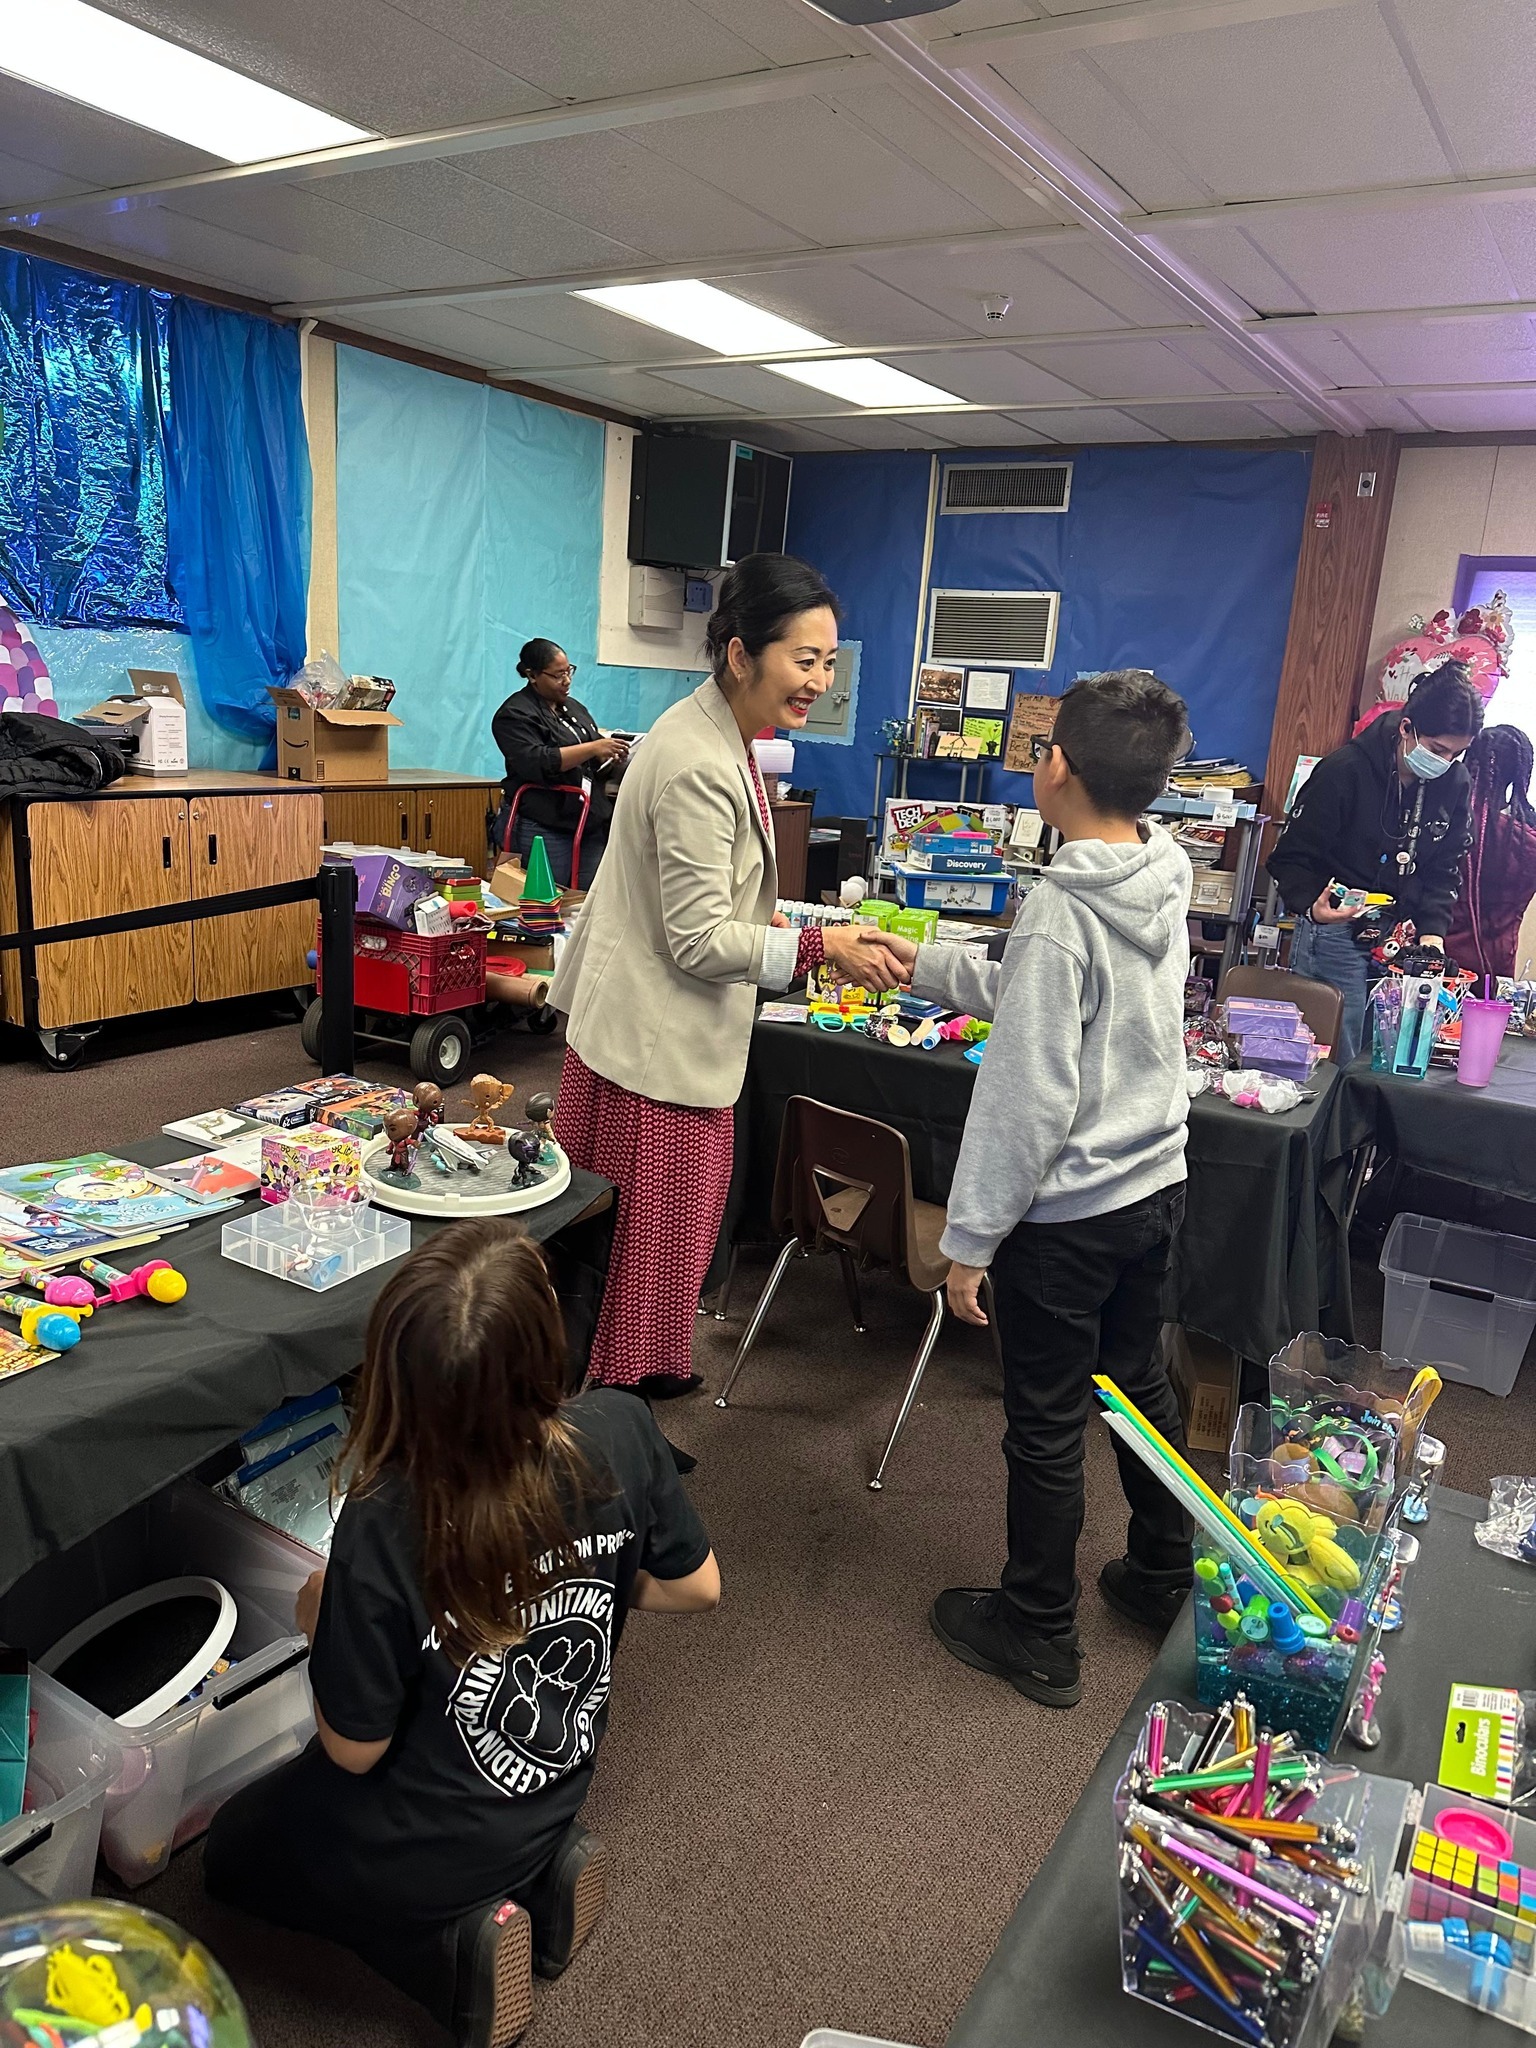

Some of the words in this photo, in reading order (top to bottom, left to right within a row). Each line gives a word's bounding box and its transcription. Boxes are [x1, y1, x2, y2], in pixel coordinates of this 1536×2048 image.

[894, 806, 921, 821] TECH
[898, 814, 926, 829] DECK
[946, 859, 987, 871] Discovery
[382, 863, 402, 898] BINGO
[896, 925, 919, 935] Magic
[1360, 1409, 1381, 1427] Join
[1469, 1717, 1491, 1777] Binoculars
